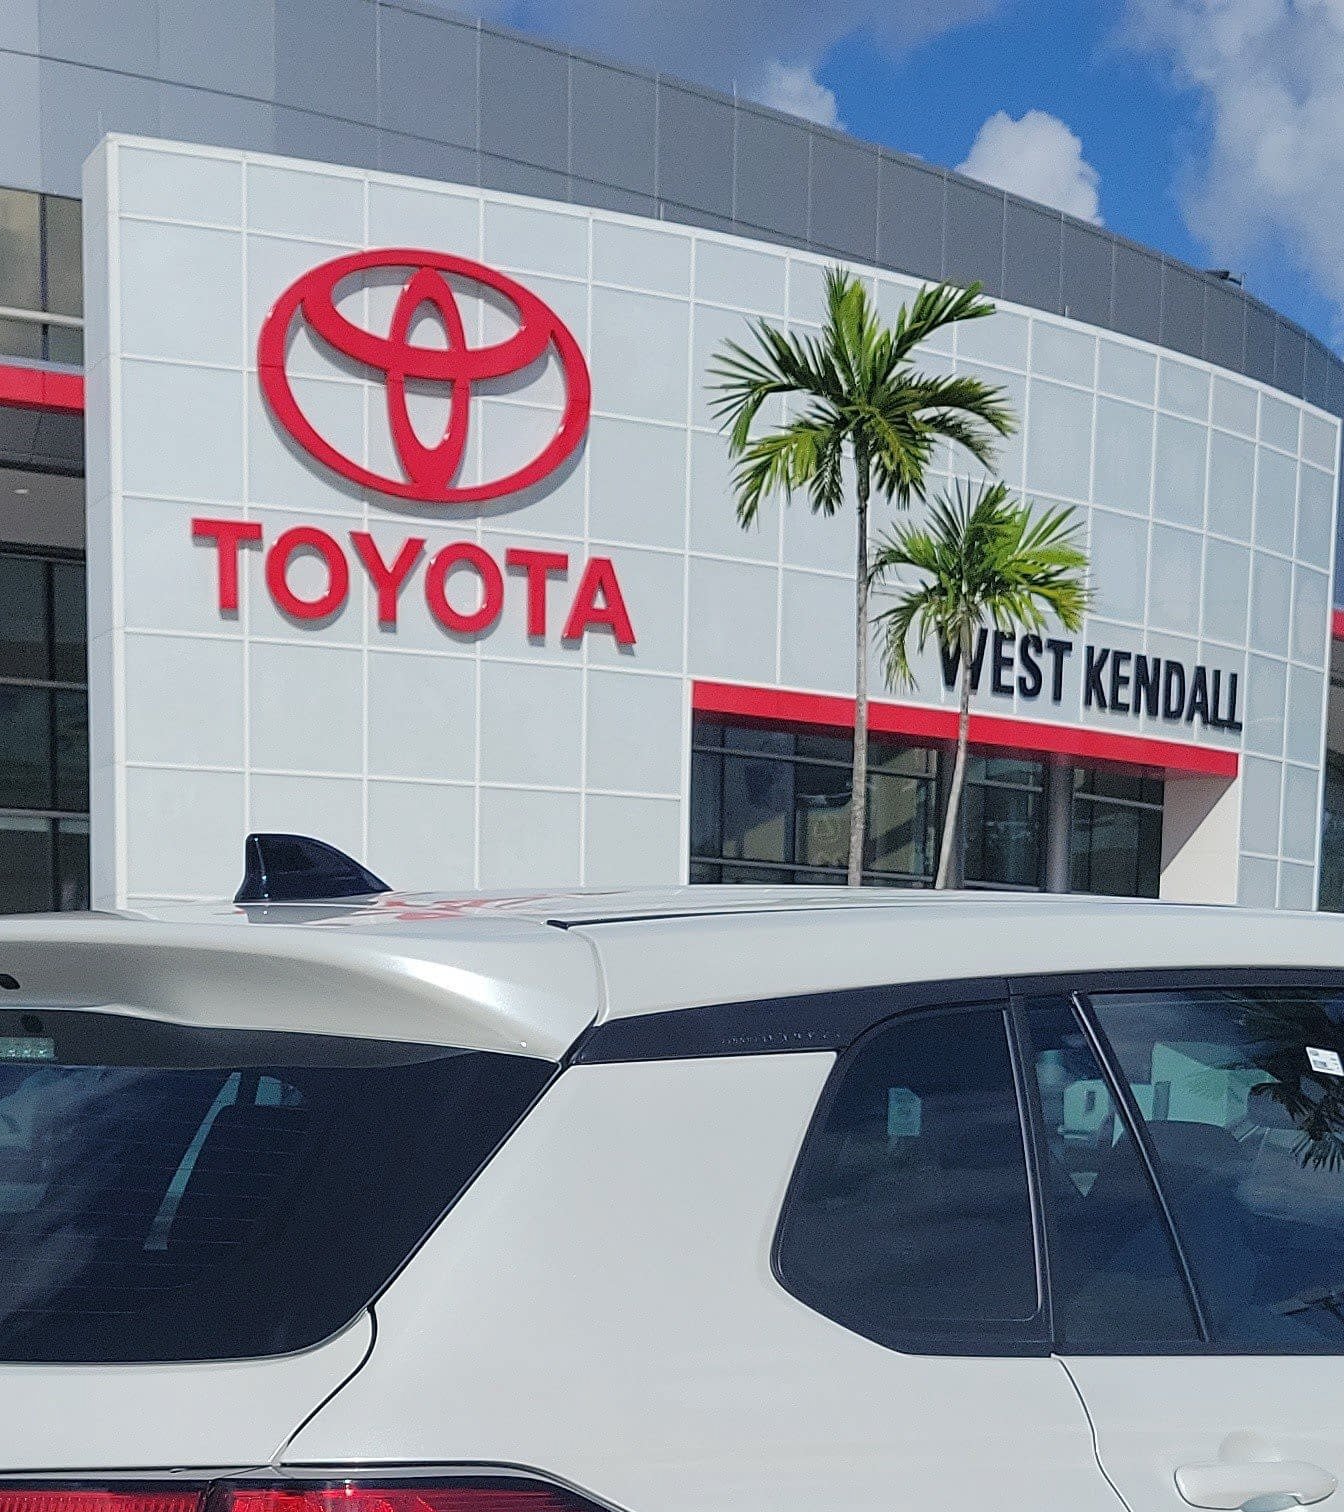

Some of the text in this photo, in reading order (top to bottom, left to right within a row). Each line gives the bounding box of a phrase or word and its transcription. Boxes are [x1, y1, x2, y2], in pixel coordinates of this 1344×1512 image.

[191, 517, 637, 649] TOYOTA
[937, 624, 1243, 731] WEST KENDALL
